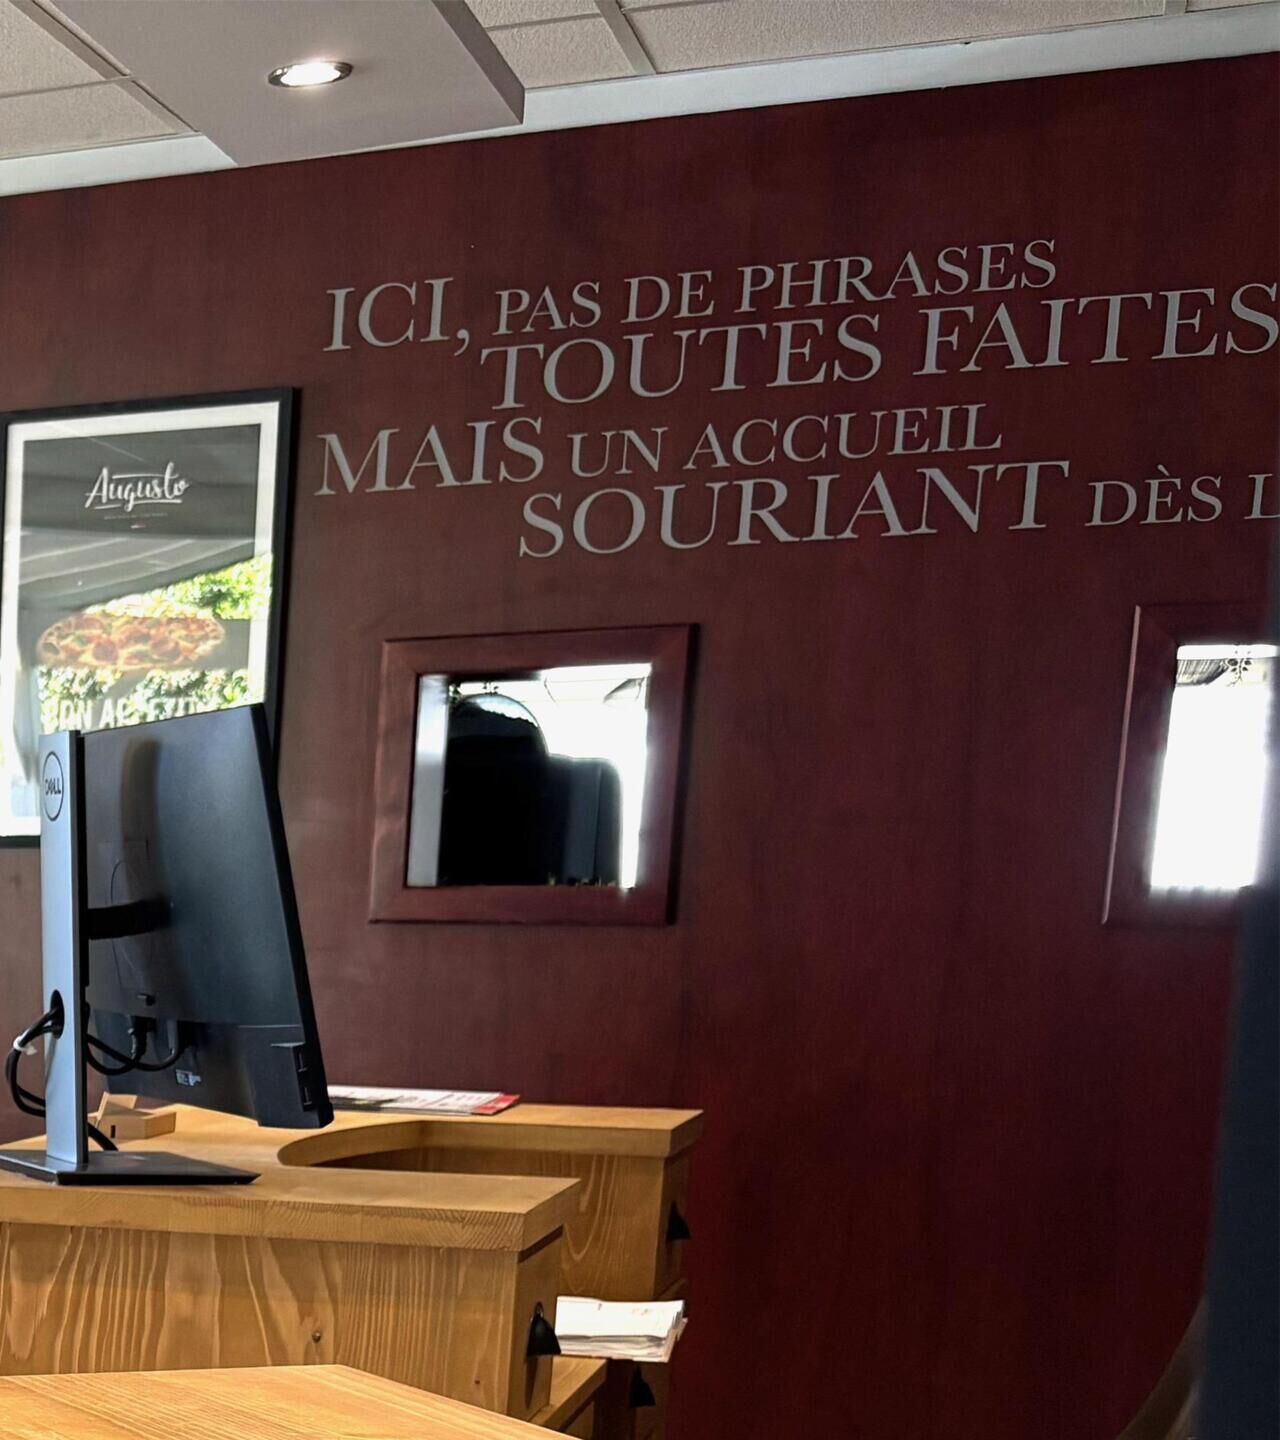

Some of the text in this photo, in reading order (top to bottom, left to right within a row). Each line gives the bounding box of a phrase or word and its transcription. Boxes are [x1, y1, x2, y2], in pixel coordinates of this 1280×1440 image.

[322, 239, 1057, 357] ICI, PAS DE PHRASES
[480, 281, 1280, 410] TOUTES FAITES
[84, 461, 190, 512] Augusto
[313, 402, 1003, 497] MAIS UN ACCUEIL
[518, 460, 1071, 559] SOURIANT
[1084, 463, 1224, 528] DÈS
